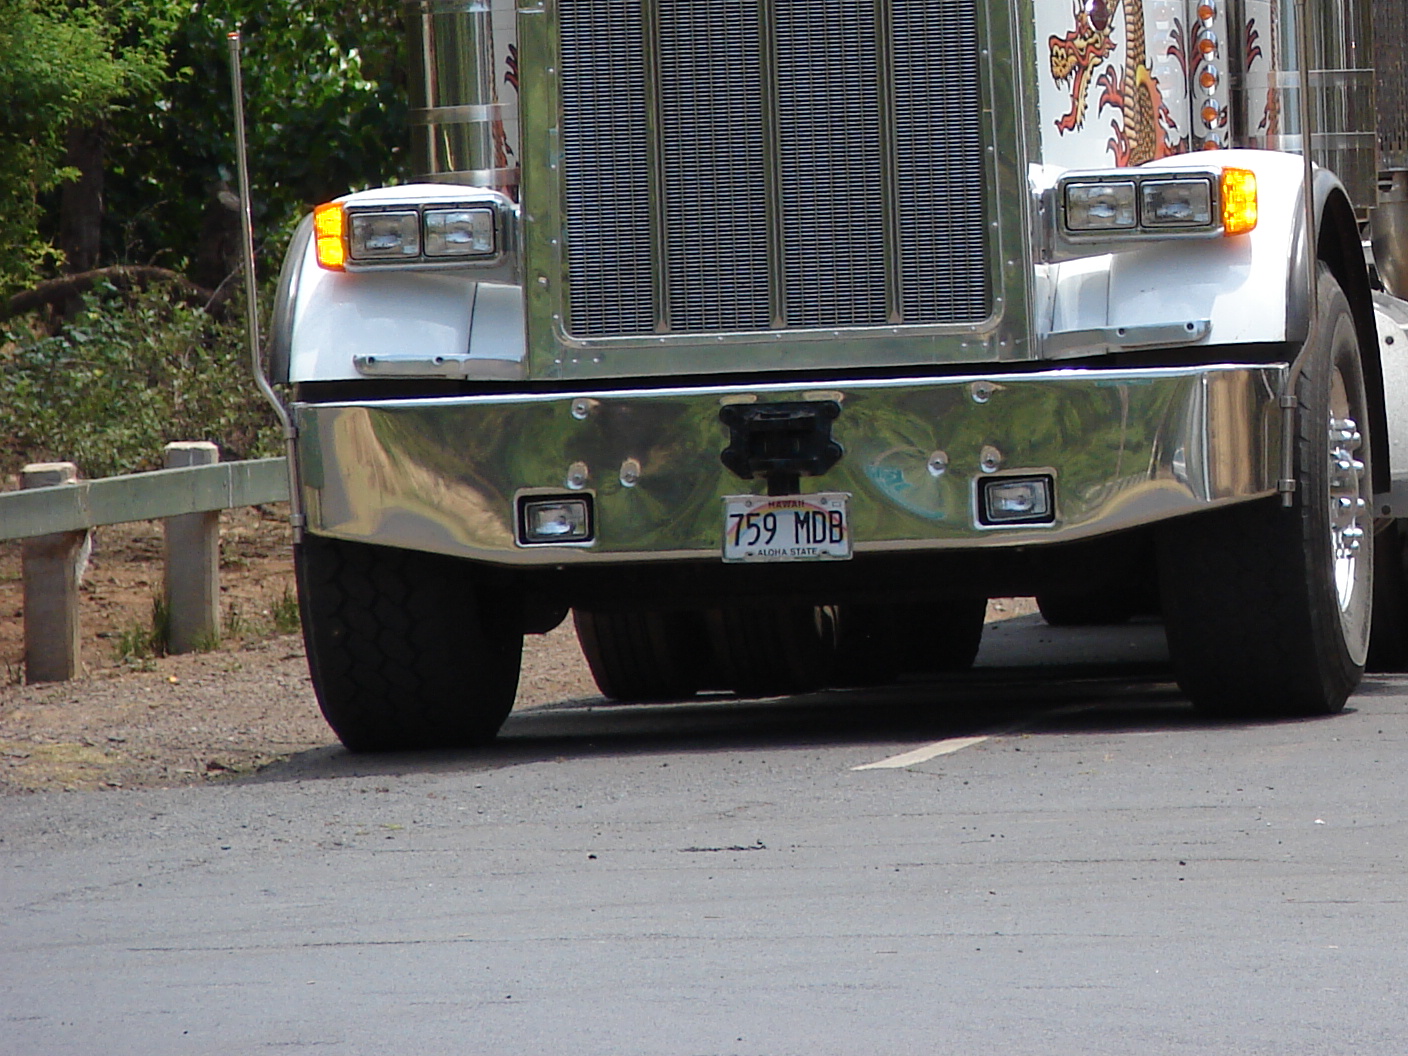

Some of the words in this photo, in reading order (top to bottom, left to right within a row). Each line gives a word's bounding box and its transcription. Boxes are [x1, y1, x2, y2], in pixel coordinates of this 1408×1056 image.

[767, 500, 805, 509] HAWAII
[729, 512, 777, 547] 759
[793, 510, 844, 544] MDB
[758, 548, 788, 557] ALOHA
[790, 547, 818, 556] STATE
